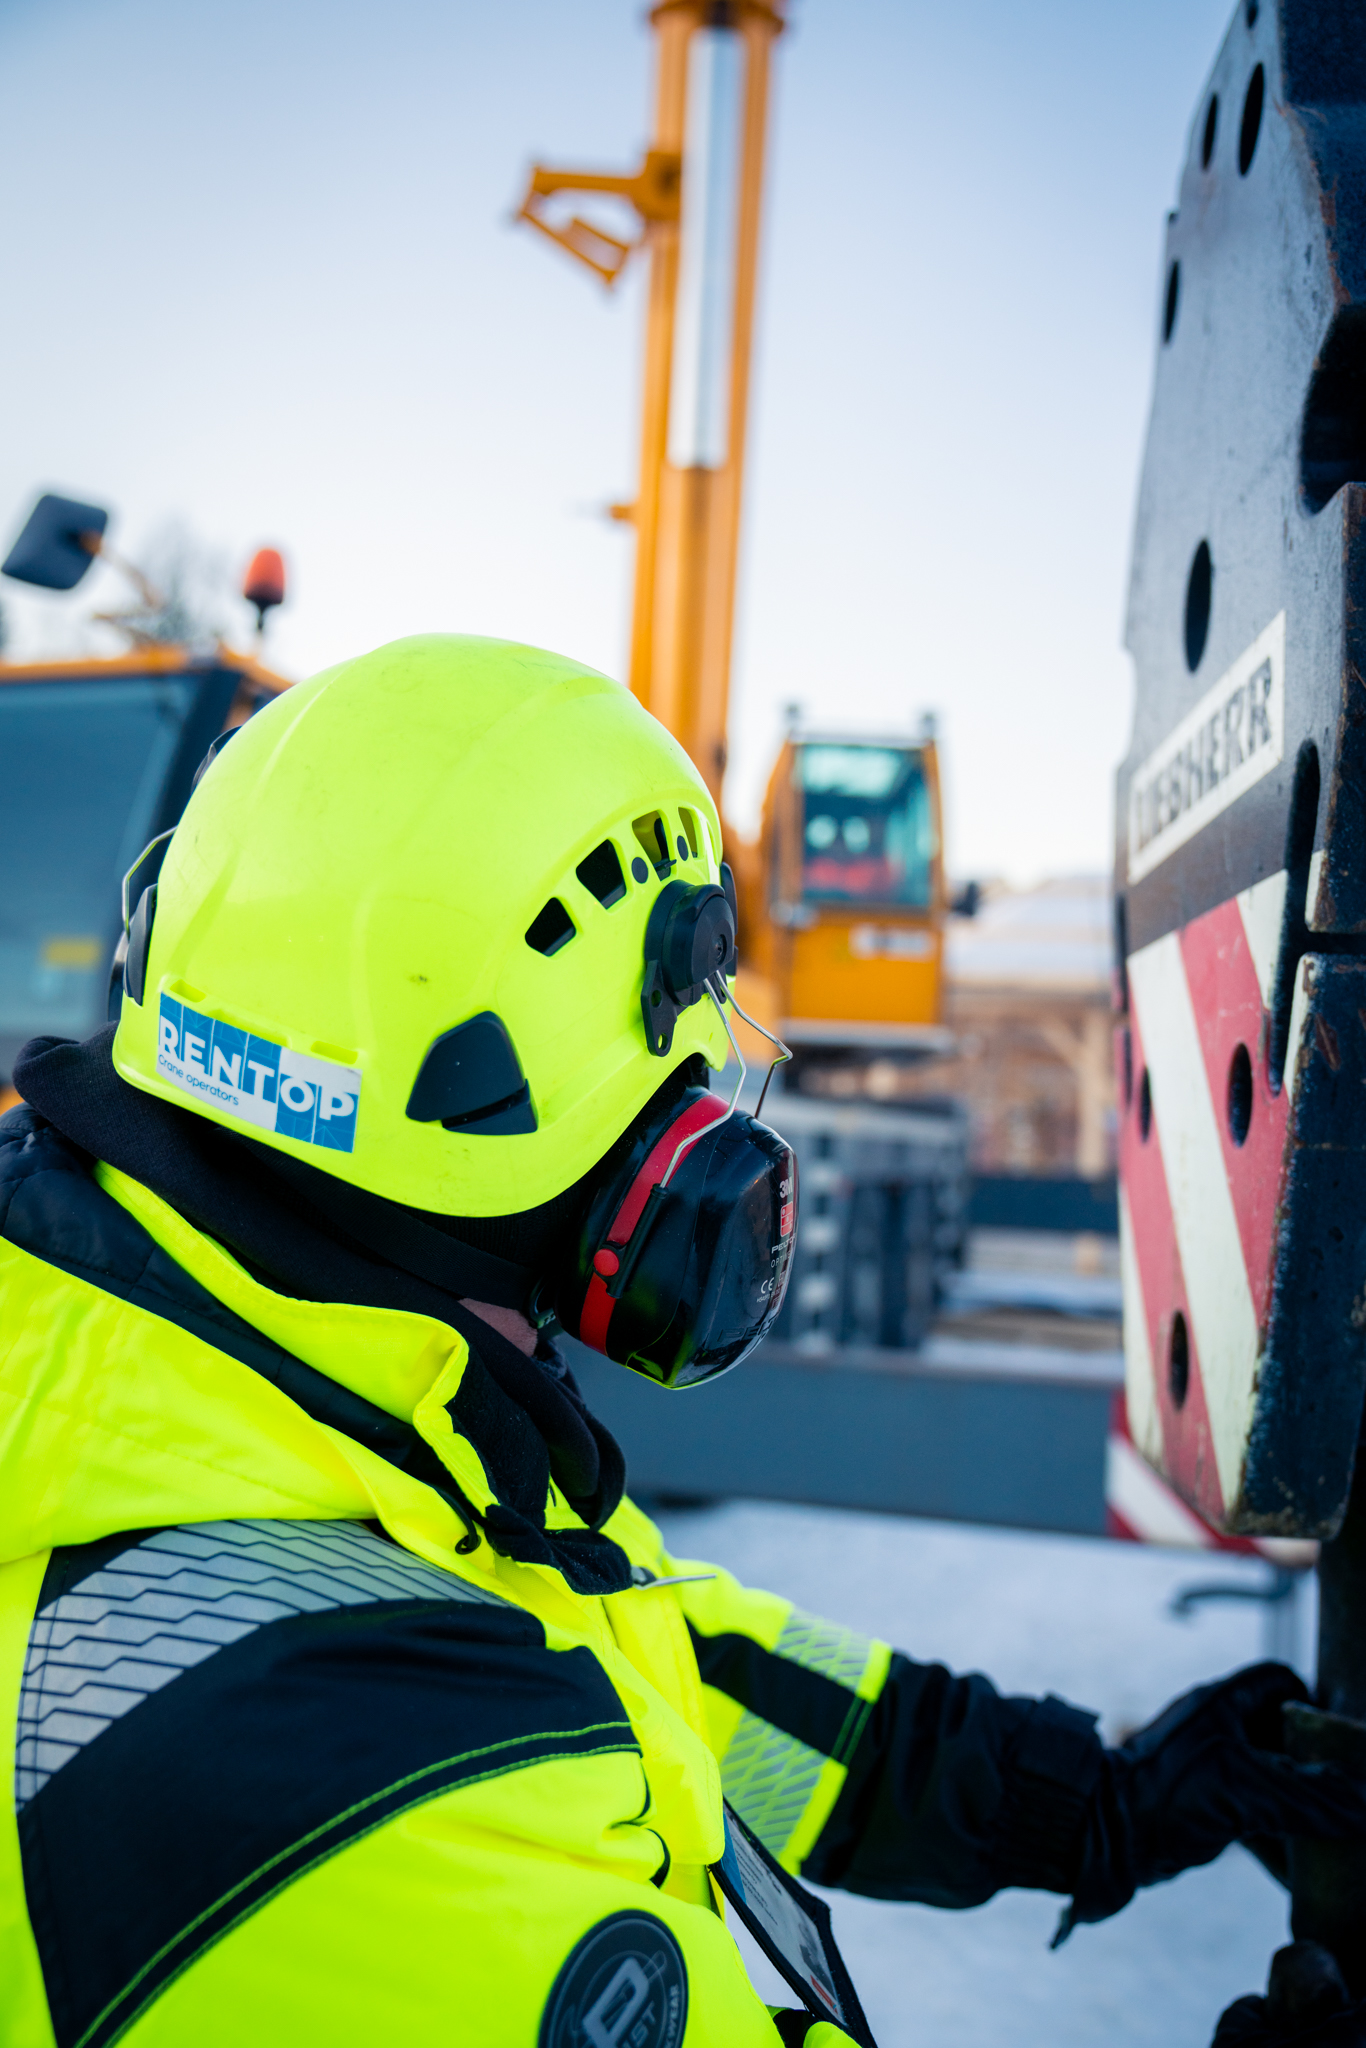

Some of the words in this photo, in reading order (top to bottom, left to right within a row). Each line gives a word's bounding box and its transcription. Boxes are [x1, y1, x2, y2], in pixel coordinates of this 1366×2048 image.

[158, 1014, 355, 1121] RENTOP
[158, 1054, 184, 1079] Crane
[186, 1073, 240, 1106] operators
[779, 1176, 793, 1199] 3M
